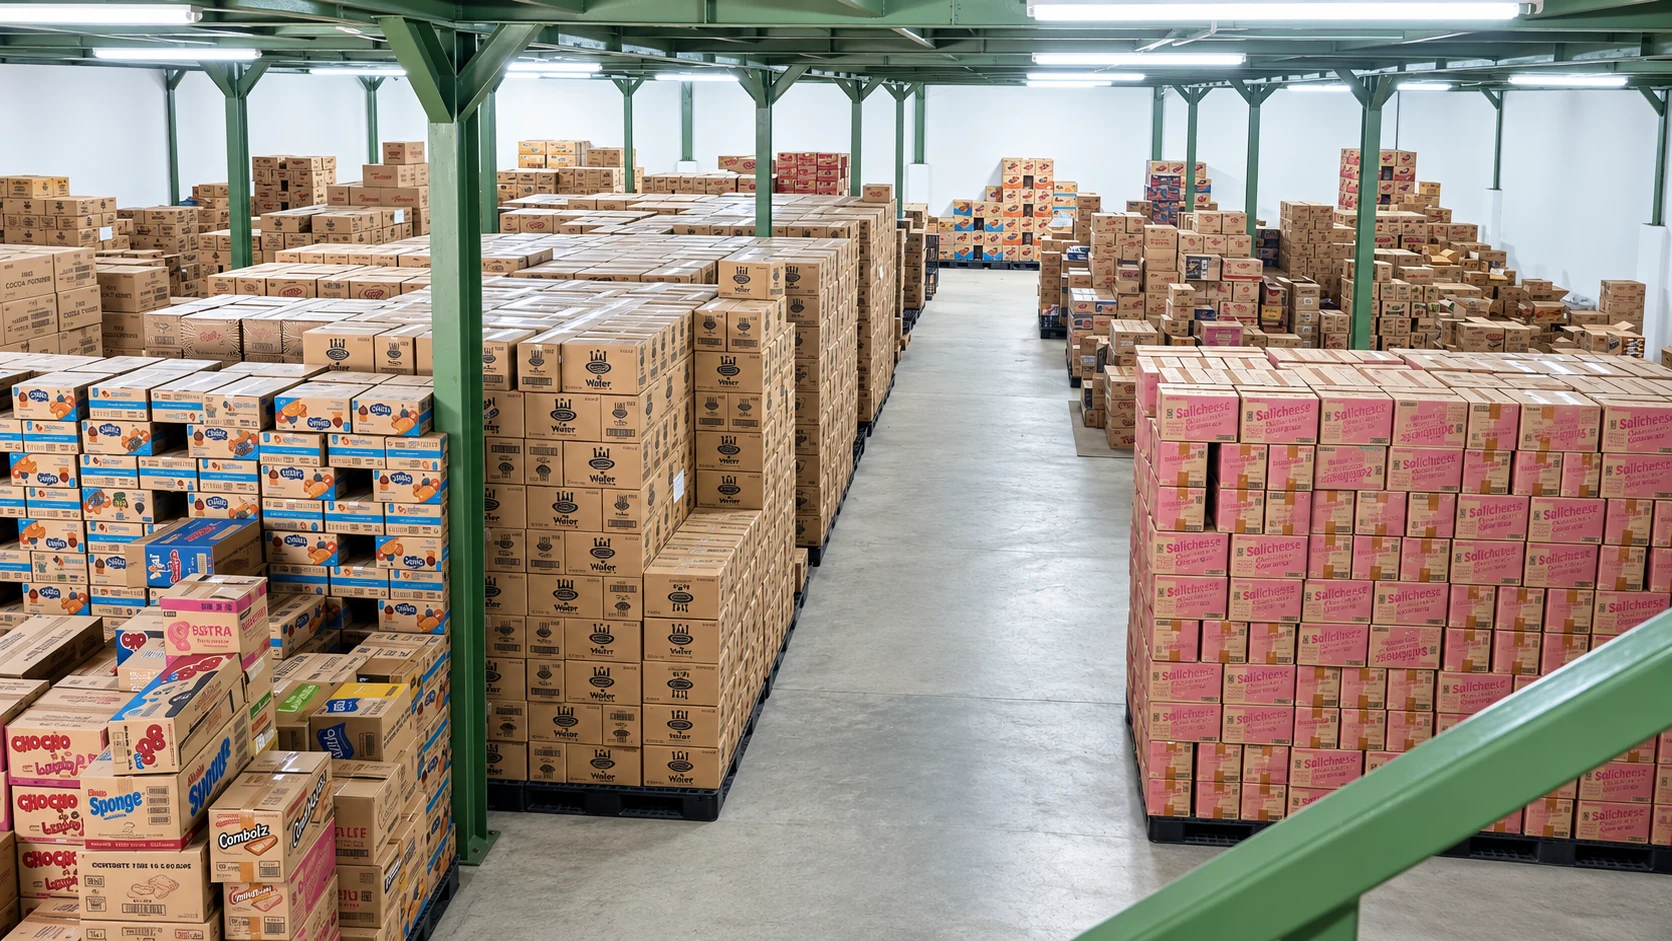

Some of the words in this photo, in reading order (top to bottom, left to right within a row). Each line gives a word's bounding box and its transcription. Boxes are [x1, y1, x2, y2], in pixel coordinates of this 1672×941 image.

[1256, 403, 1310, 421] Salicheese
[1620, 414, 1672, 429] Salichees
[1544, 505, 1597, 520] Salicheese
[1246, 541, 1300, 557] Salicheese
[1388, 588, 1441, 603] Salicheese
[89, 792, 143, 817] Sponge
[219, 825, 269, 848] Combolz
